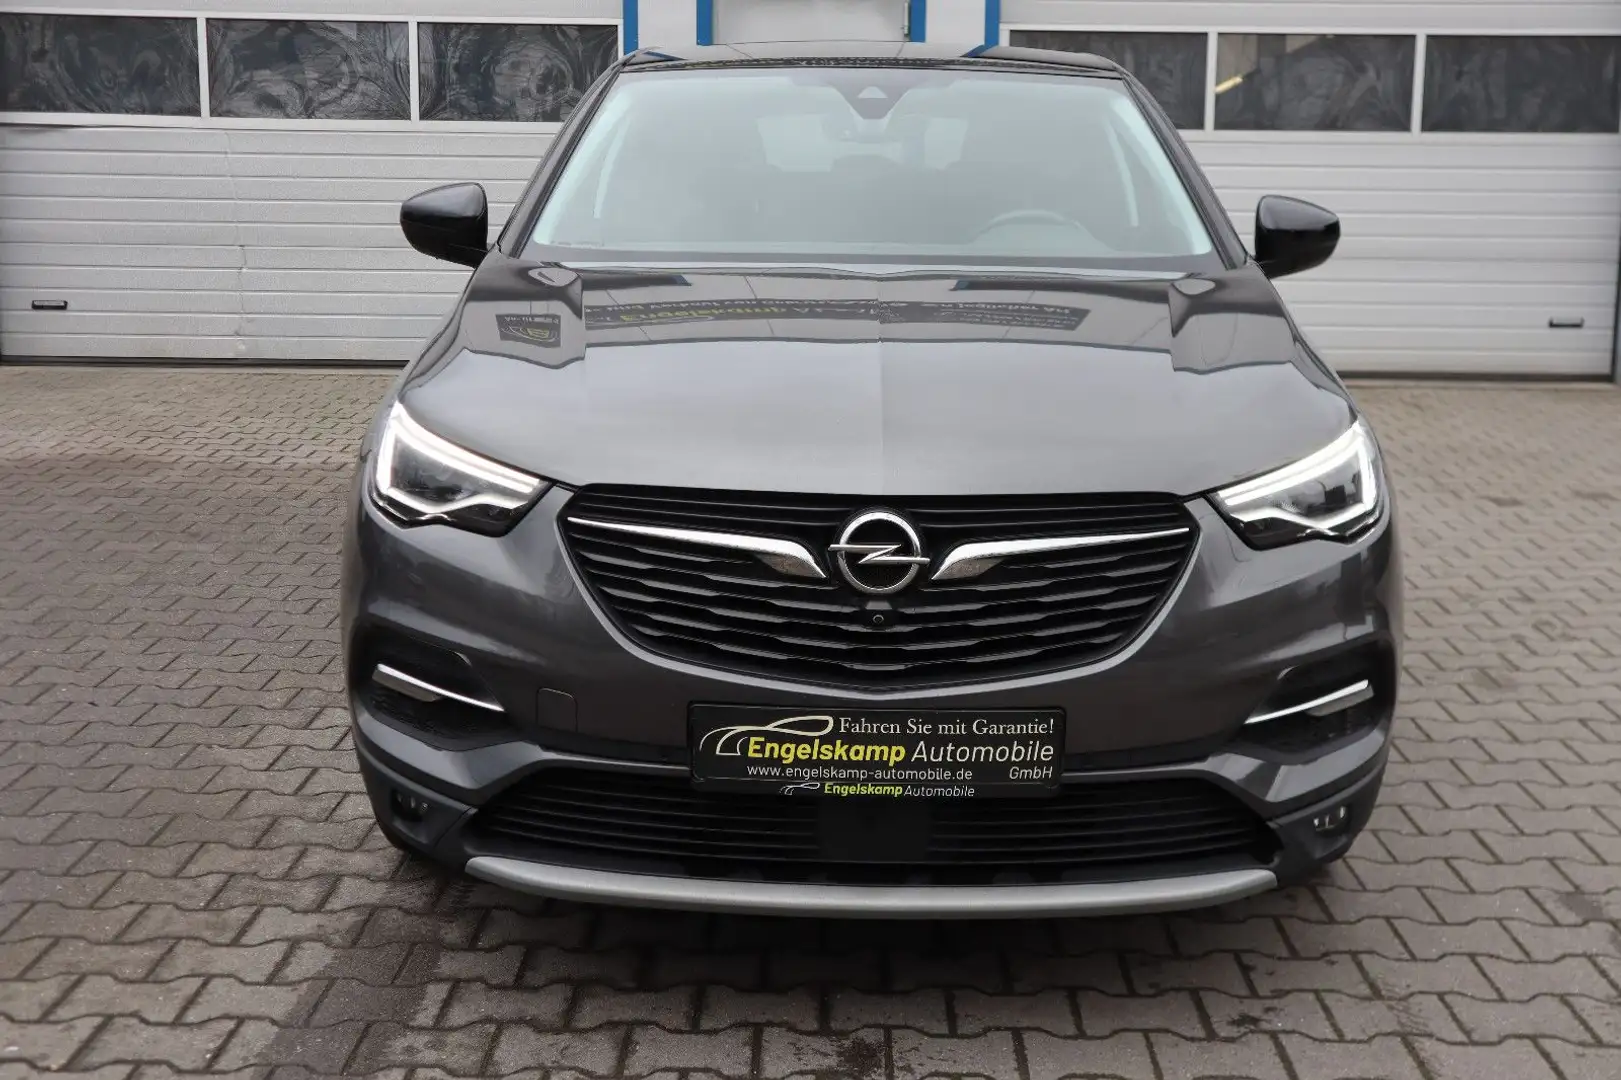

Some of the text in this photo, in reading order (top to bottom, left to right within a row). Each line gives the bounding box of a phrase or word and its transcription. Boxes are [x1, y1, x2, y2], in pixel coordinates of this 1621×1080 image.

[839, 718, 1054, 735] Fahren Sie mit Garantie!
[747, 736, 1054, 767] Engelskamp Automobile
[746, 764, 973, 783] www.engelskamp-automobile.de
[1009, 765, 1053, 780] GmbH
